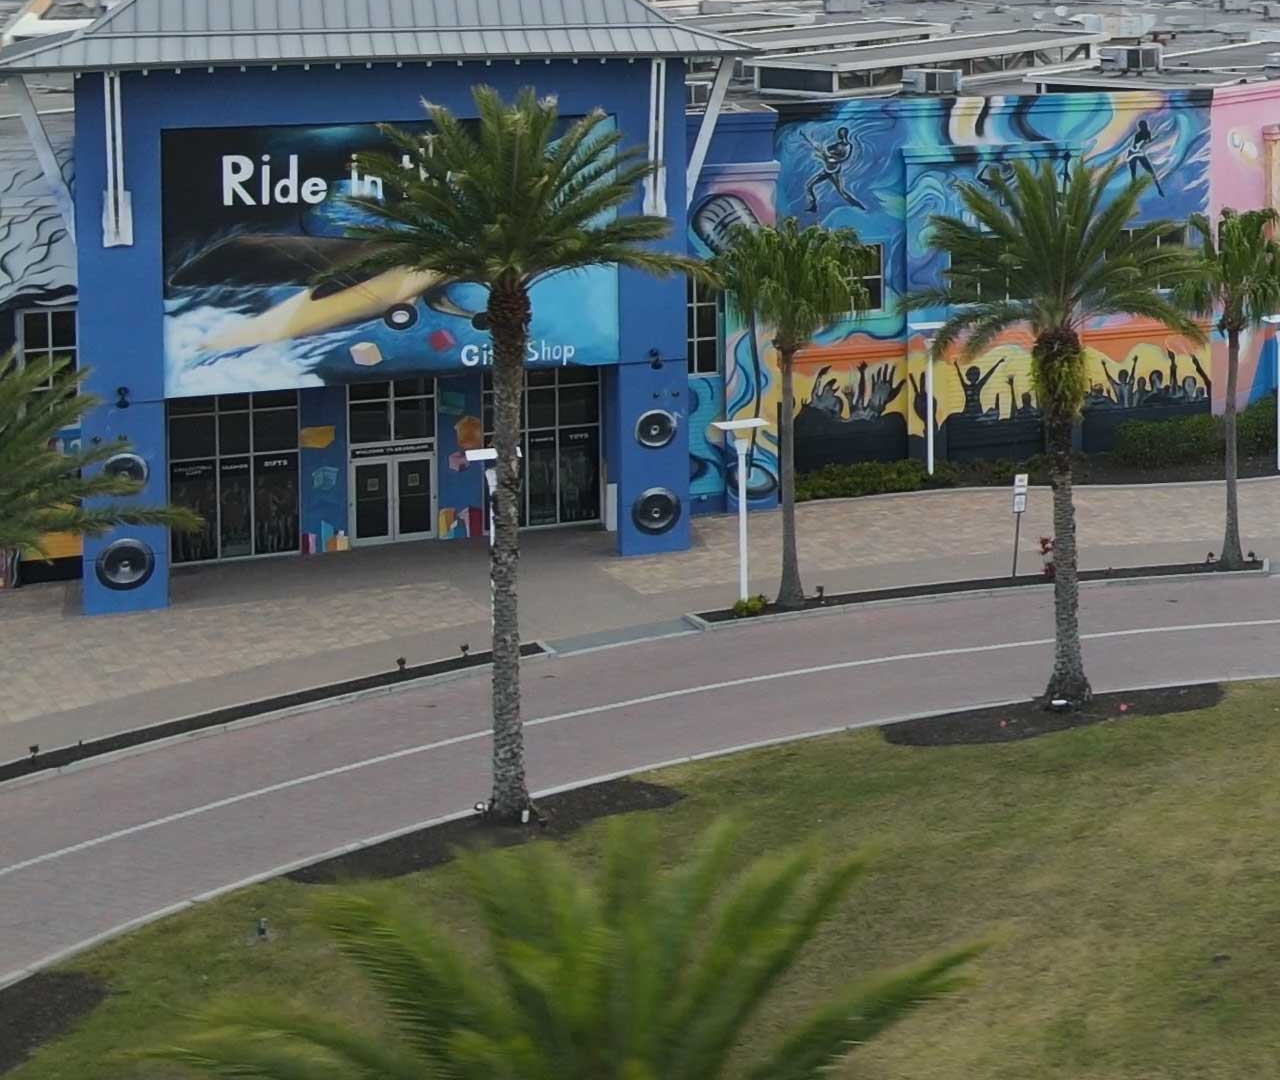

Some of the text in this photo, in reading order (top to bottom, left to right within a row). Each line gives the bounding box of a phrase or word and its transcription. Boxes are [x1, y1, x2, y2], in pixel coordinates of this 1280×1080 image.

[221, 153, 328, 207] Ride
[351, 153, 383, 200] in
[526, 339, 575, 366] Shop
